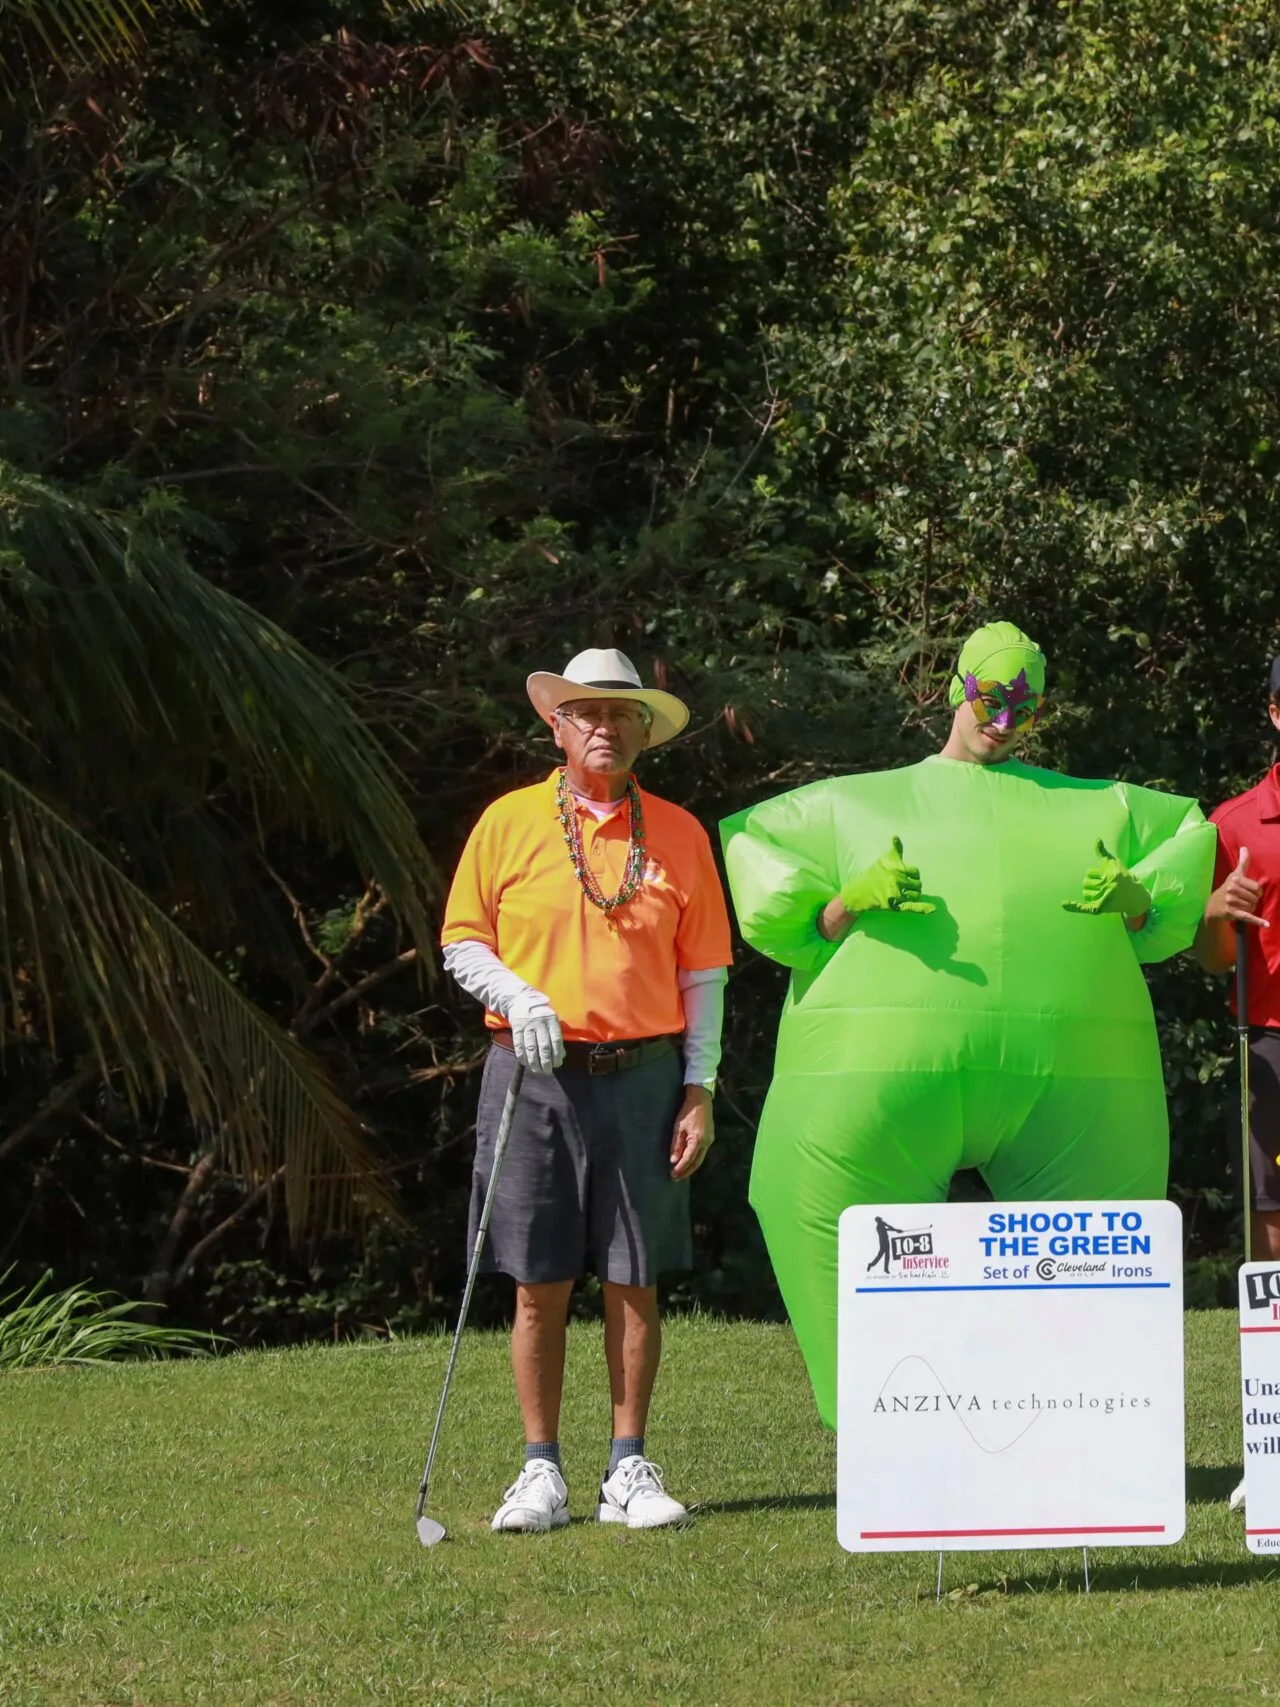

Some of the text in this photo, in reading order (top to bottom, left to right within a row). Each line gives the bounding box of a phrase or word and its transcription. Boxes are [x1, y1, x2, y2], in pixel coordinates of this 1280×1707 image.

[988, 1212, 1142, 1233] SHOOT TO
[895, 1236, 930, 1255] 10-8
[979, 1236, 1150, 1257] THE GREEN
[903, 1256, 949, 1269] InService
[983, 1267, 1008, 1279] Set
[1013, 1265, 1030, 1278] of
[1057, 1262, 1107, 1272] Cleveland
[1112, 1265, 1152, 1277] Irons
[873, 1392, 1151, 1414] ANZIVA technologies
